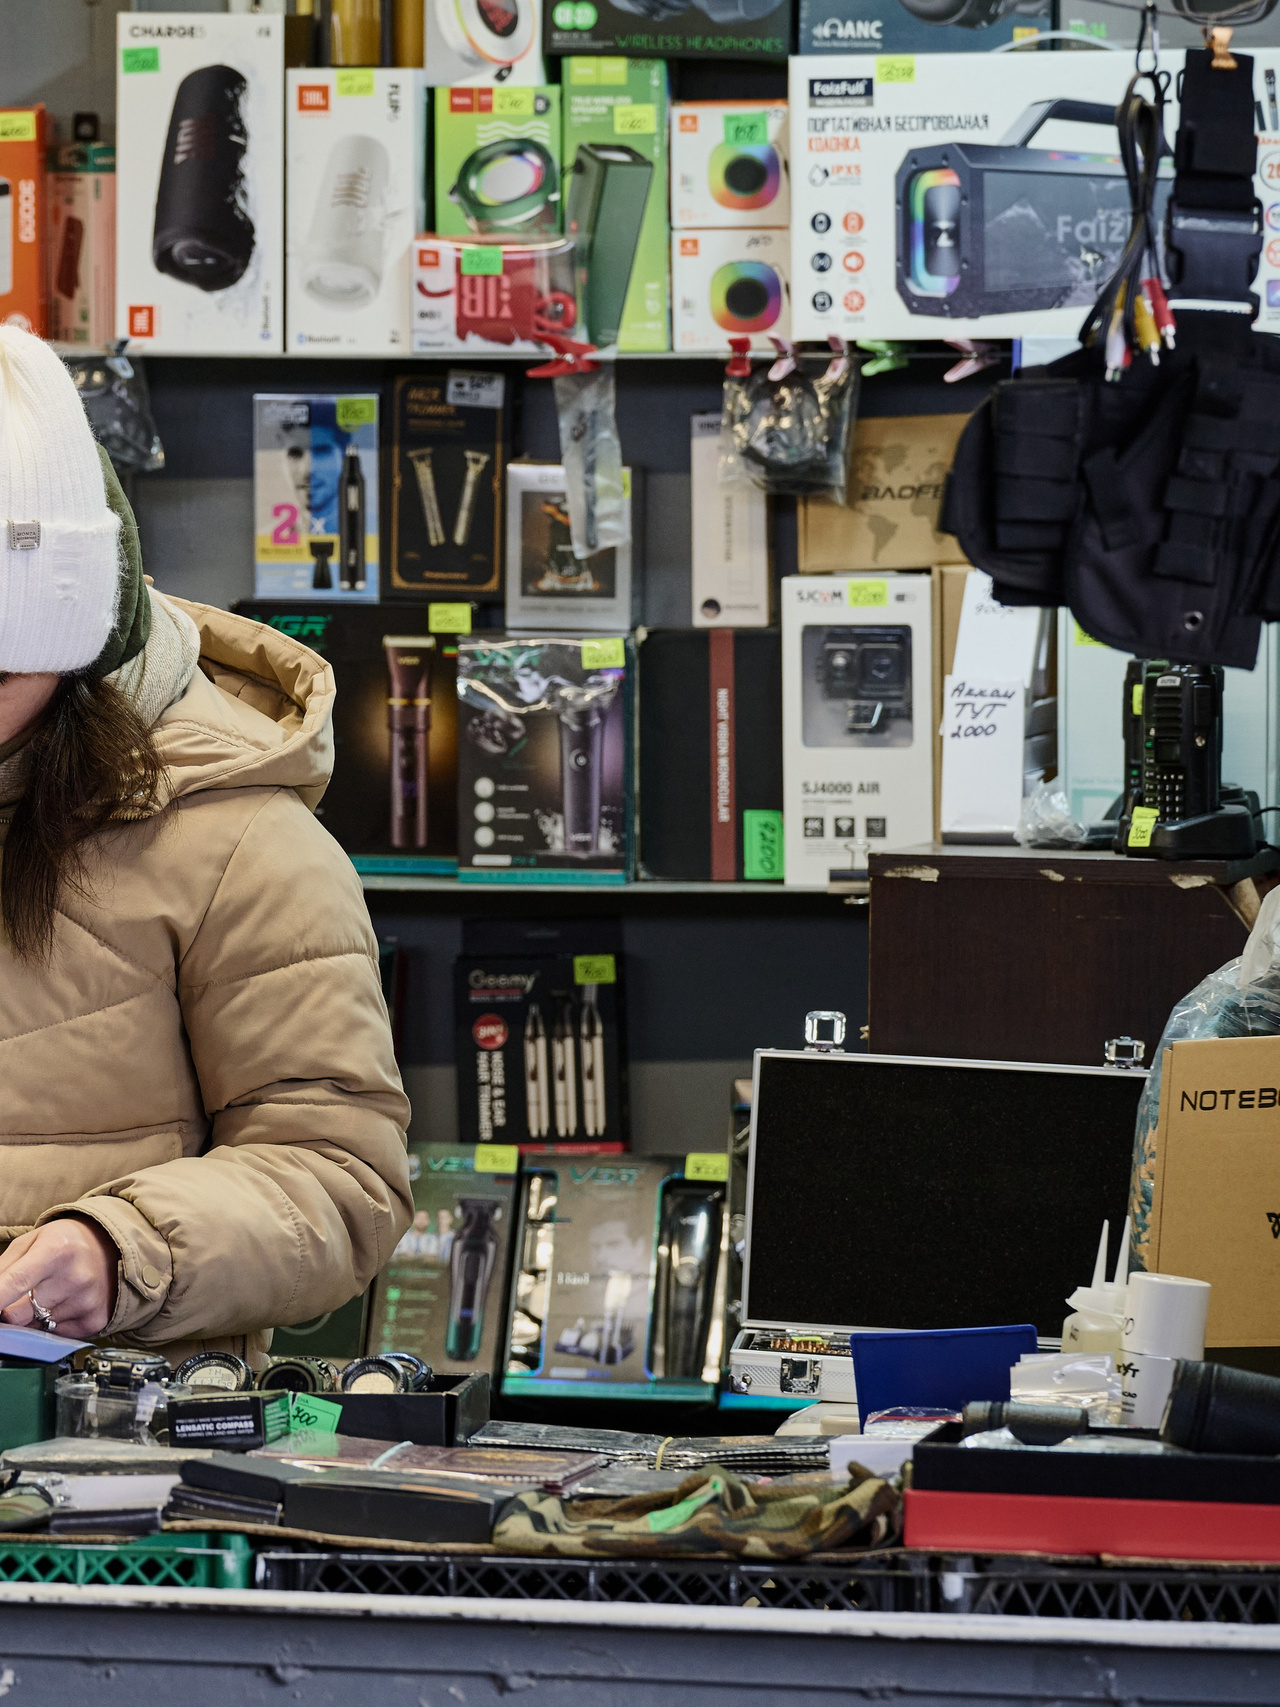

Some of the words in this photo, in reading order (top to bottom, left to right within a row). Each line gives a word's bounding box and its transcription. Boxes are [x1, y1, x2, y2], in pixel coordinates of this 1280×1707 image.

[843, 20, 883, 39] ANC
[615, 35, 682, 50] WIRELESS
[686, 36, 783, 52] HEADPHONES
[272, 503, 300, 546] 2
[802, 782, 852, 794] SJ4000
[857, 782, 880, 794] AIR
[1180, 1088, 1280, 1112] NOTEB
[175, 1423, 215, 1433] LENSATIC
[215, 1420, 255, 1430] COMPASS
